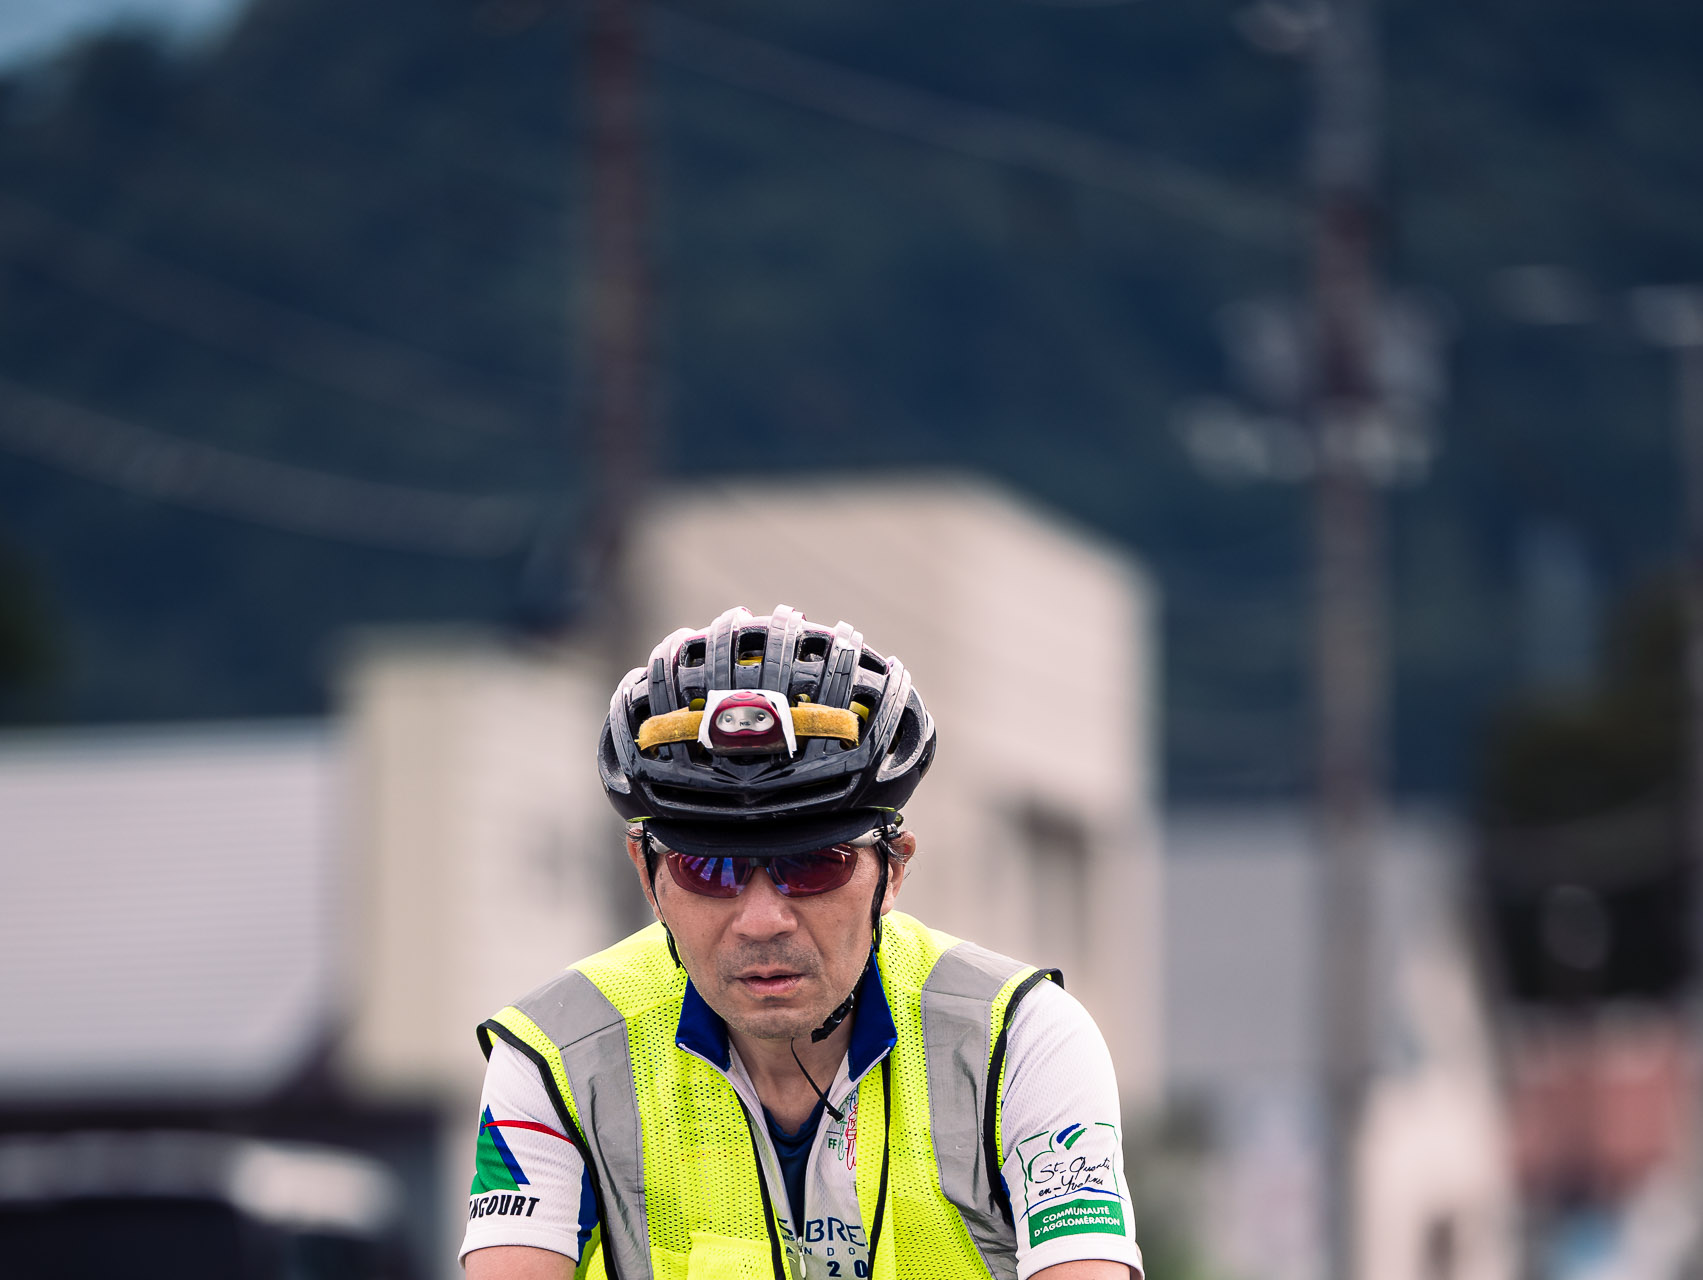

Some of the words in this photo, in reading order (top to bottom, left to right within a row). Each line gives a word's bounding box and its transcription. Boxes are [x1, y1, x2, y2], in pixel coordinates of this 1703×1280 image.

[469, 1195, 540, 1220] NCOURT
[1042, 1205, 1110, 1224] COMMUNAUTÉ
[805, 1216, 869, 1247] BRE
[1034, 1216, 1120, 1238] D'AGGLOMÉRATION
